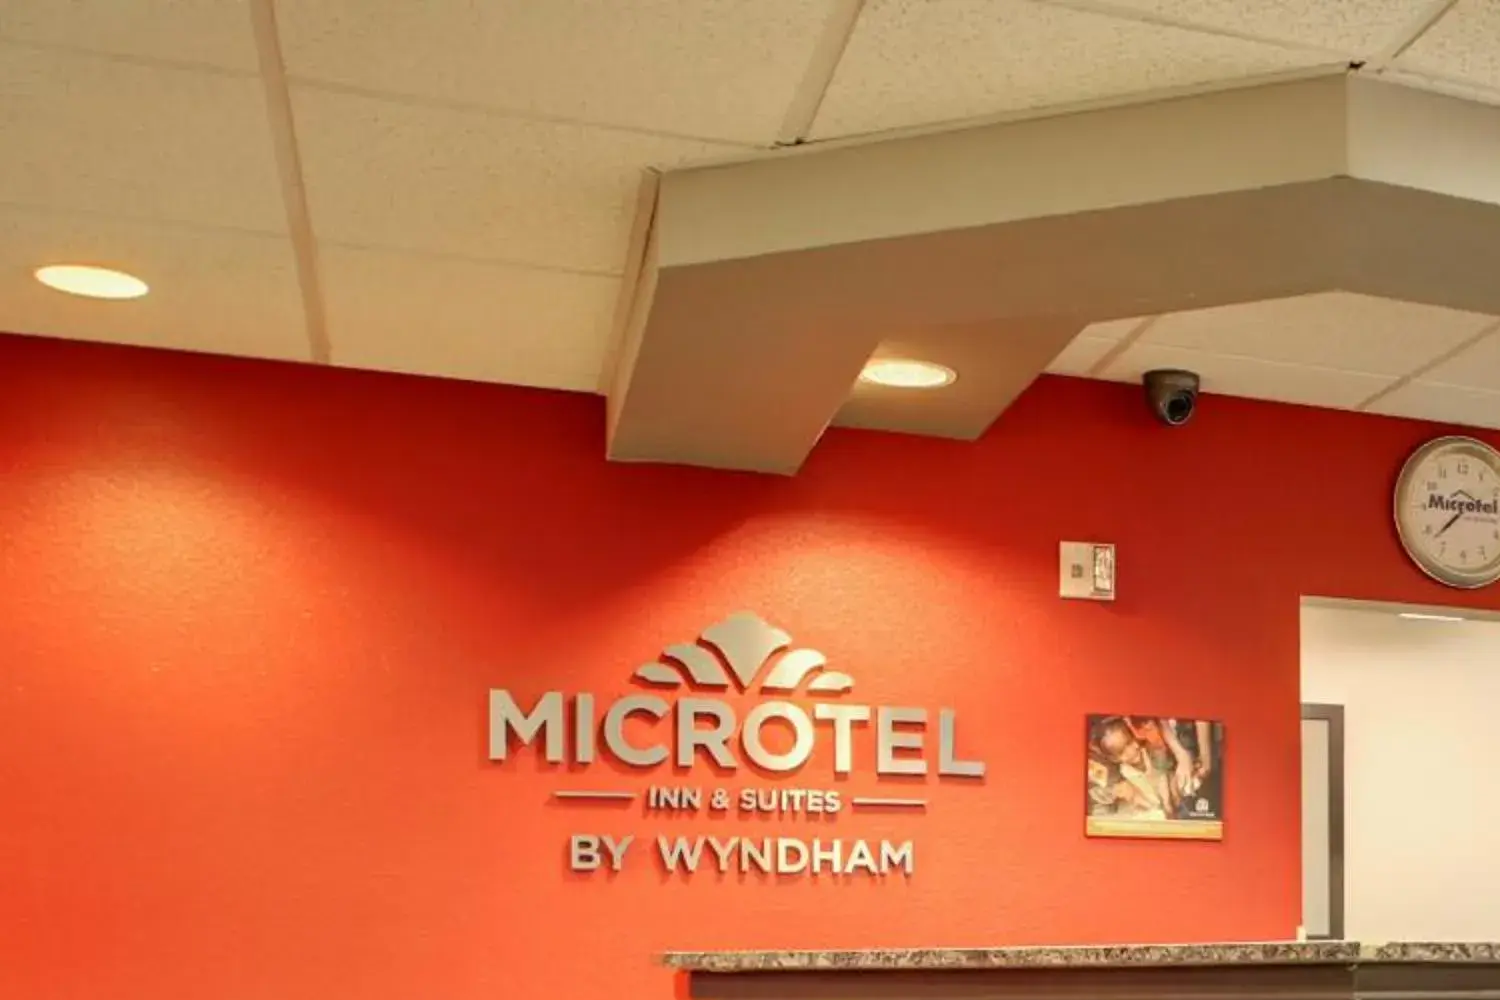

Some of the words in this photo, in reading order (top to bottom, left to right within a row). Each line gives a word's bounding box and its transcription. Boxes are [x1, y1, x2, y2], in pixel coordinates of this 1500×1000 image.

[1428, 493, 1498, 514] Microtel
[488, 688, 986, 779] MICROTEL
[649, 785, 701, 810] INN
[711, 789, 729, 811] &
[740, 789, 842, 814] SUITES
[569, 834, 635, 871] BY
[658, 835, 914, 875] WYNDHAM
